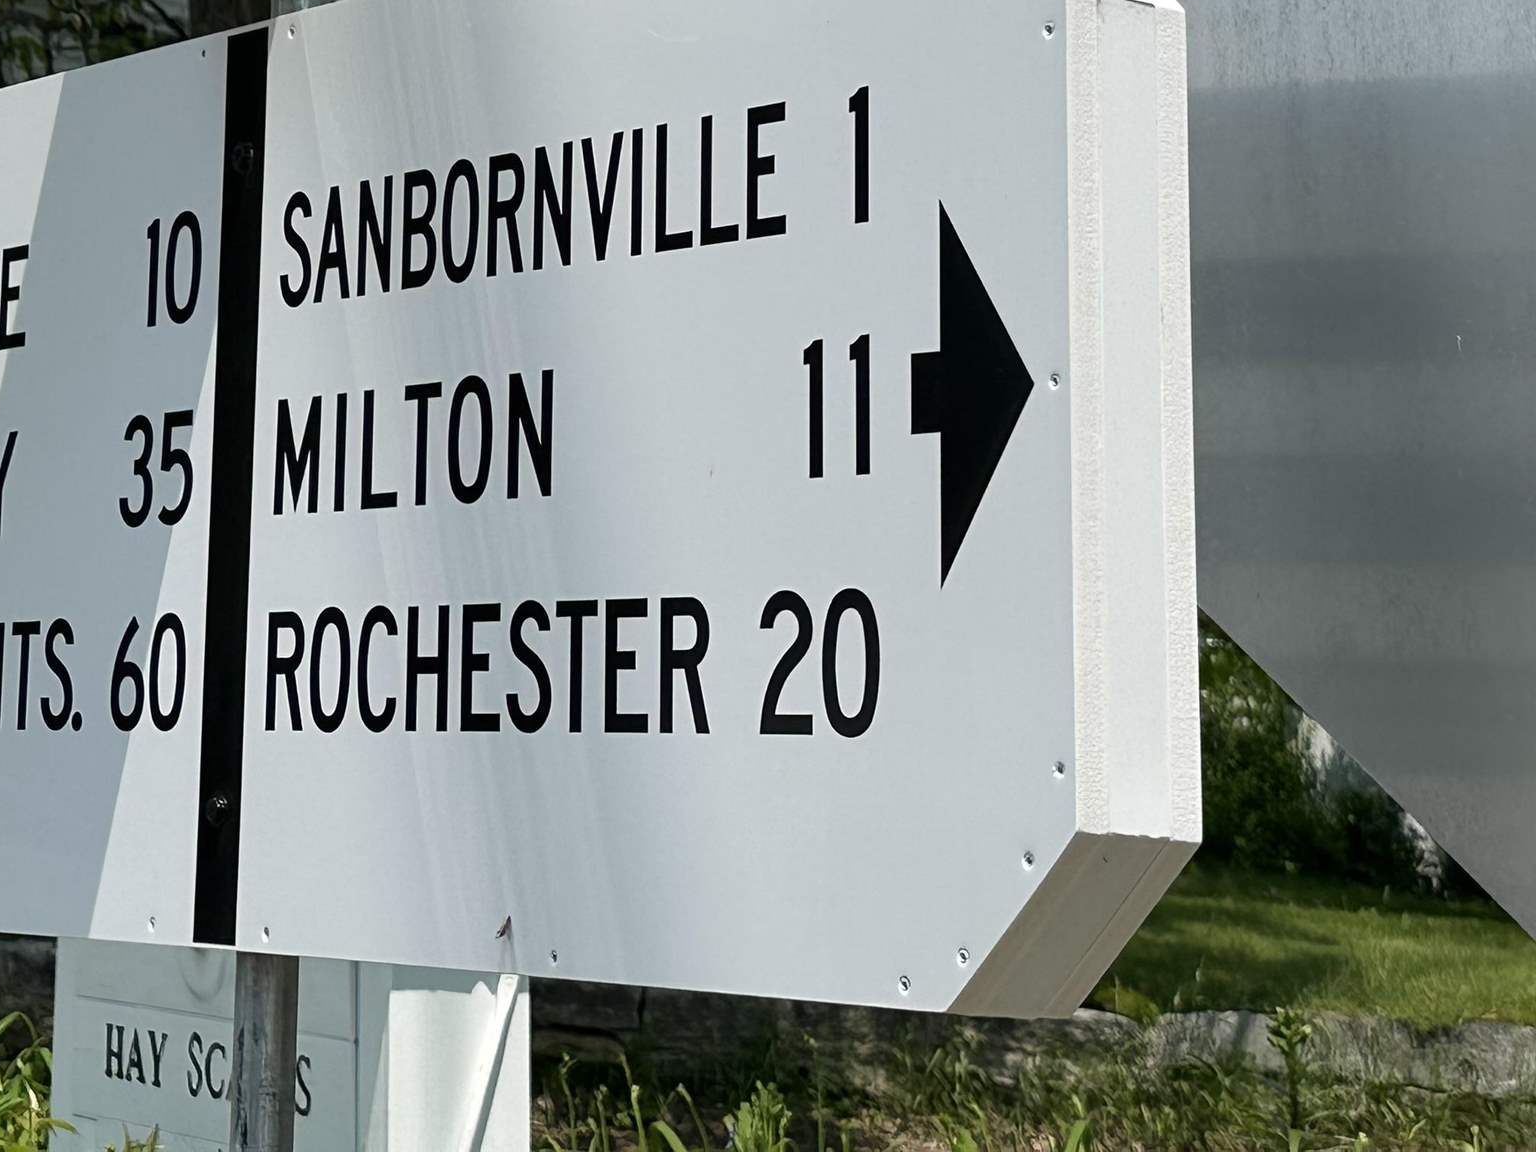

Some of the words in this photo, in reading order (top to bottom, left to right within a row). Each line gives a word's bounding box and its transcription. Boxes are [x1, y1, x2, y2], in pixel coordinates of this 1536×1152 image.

[279, 101, 787, 308] SANBORNVILLE
[848, 85, 870, 224] 1
[146, 210, 203, 328] 10
[118, 409, 194, 529] 35
[273, 369, 554, 516] MILTON
[803, 333, 871, 479] 11
[110, 612, 187, 732] 60
[264, 596, 710, 735] ROCHESTER
[759, 588, 881, 739] 20
[104, 1022, 169, 1089] HAY
